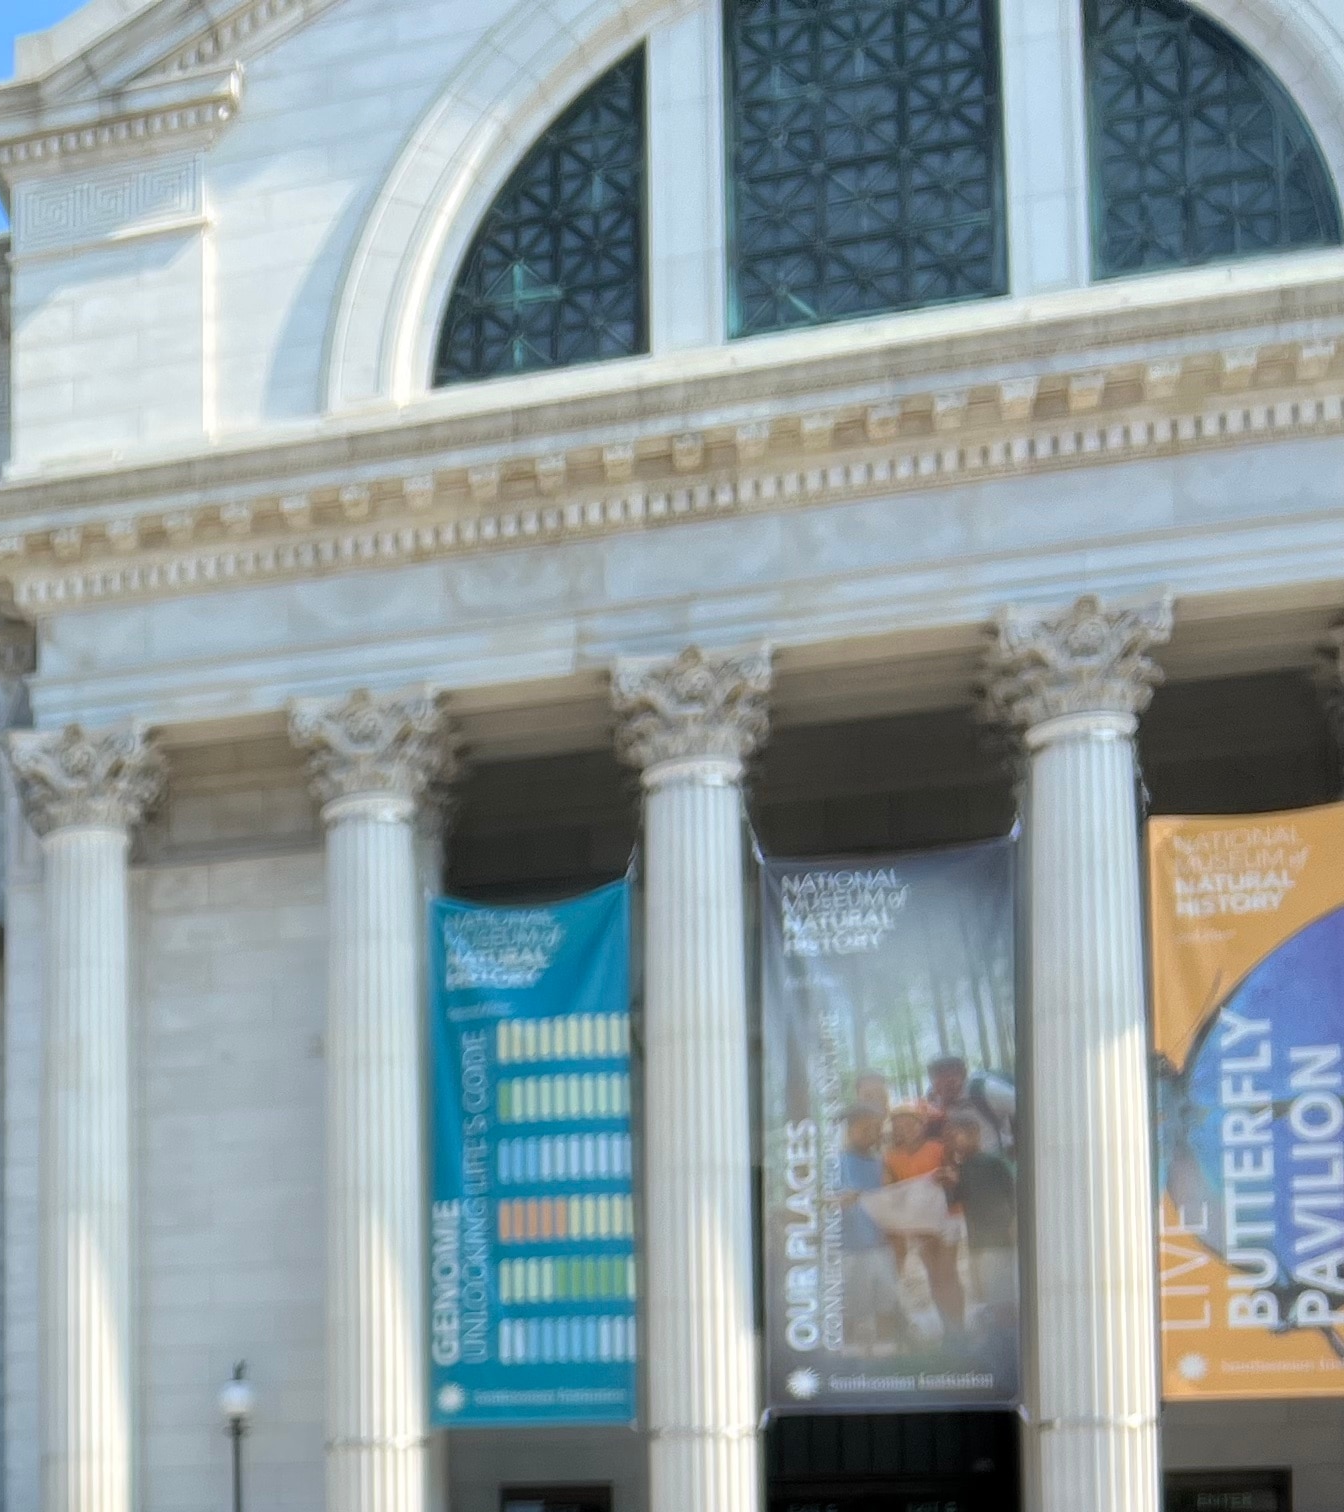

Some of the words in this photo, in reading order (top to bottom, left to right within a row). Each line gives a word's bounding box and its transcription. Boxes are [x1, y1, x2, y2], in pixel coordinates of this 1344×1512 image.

[1174, 825, 1300, 851] NATIONAL
[1175, 869, 1296, 893] NATURAL
[781, 868, 899, 895] NATIONAL
[782, 887, 885, 913] MUSEUM
[783, 907, 895, 933] NATURAL
[1176, 890, 1285, 917] HISTORY
[461, 1028, 490, 1113] CODE
[784, 1119, 818, 1260] PLACES
[1219, 1008, 1279, 1328] BUTTERFLY
[1289, 1043, 1344, 1327] PAVILION
[433, 1199, 461, 1366] GENOME
[462, 1198, 490, 1365] UNLOCKING
[784, 1265, 820, 1351] OUR
[822, 1201, 845, 1351] CONNECTING
[1159, 1200, 1210, 1330] LIVE
